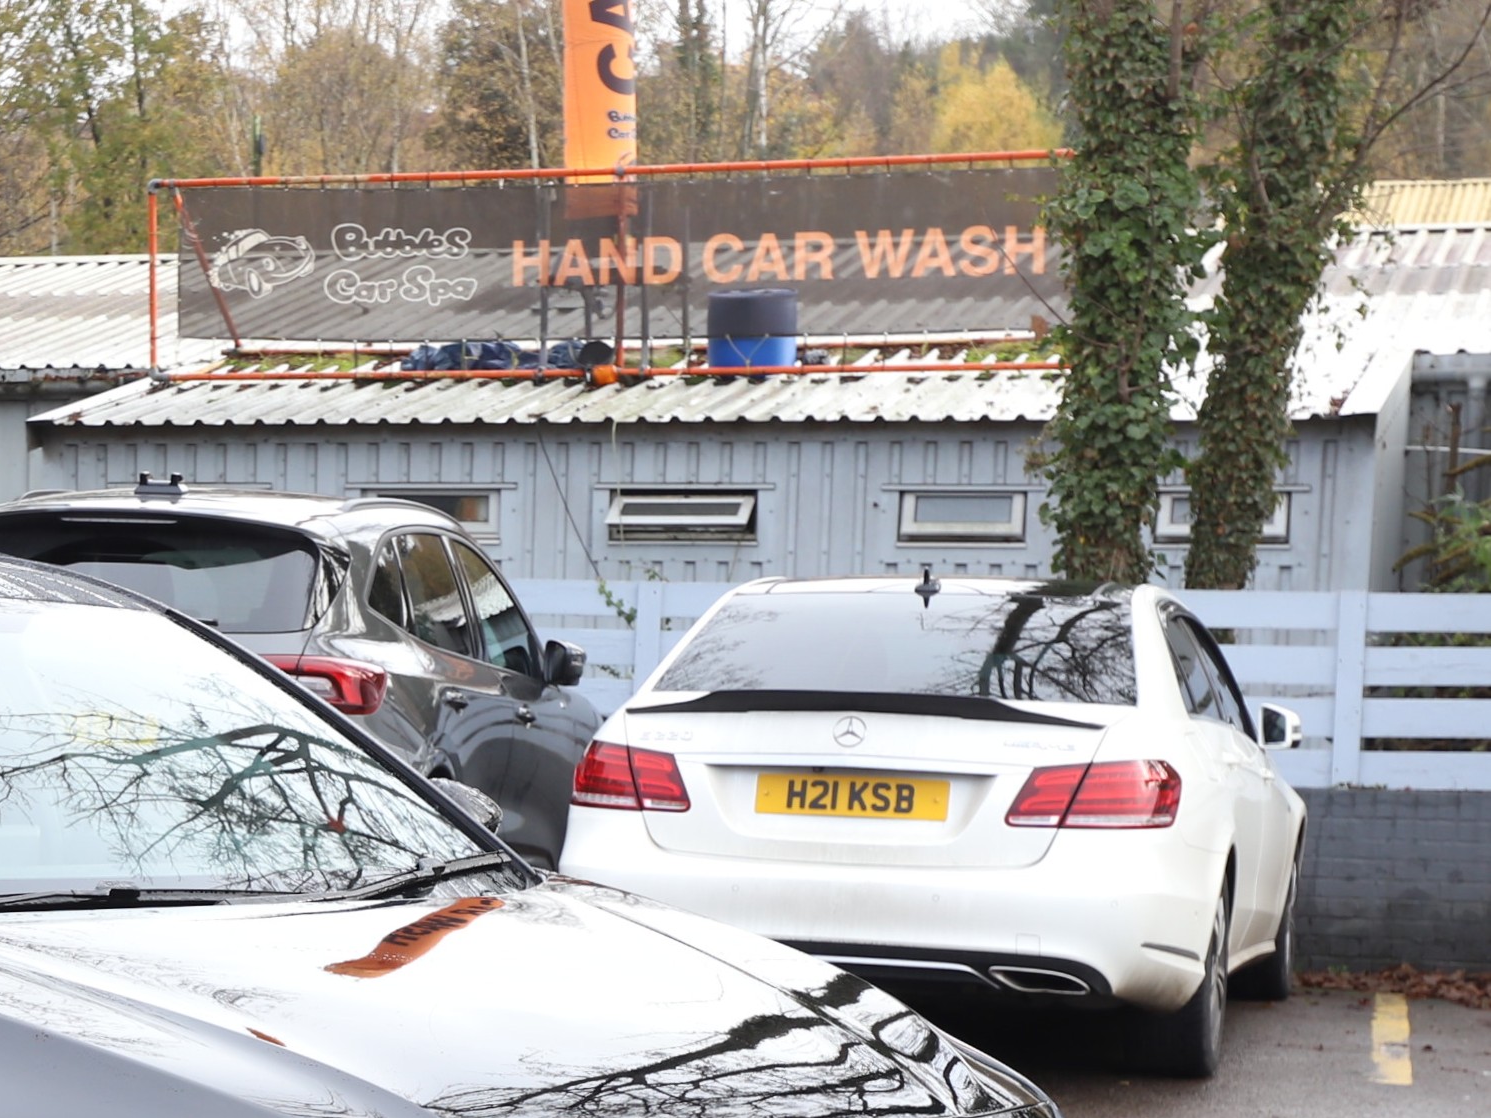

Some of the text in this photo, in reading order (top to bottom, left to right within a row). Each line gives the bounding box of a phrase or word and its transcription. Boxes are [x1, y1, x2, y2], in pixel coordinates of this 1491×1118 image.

[512, 225, 1047, 287] HAND CAR WASH
[324, 265, 478, 306] Car Spa
[786, 779, 916, 814] H21 KSB
